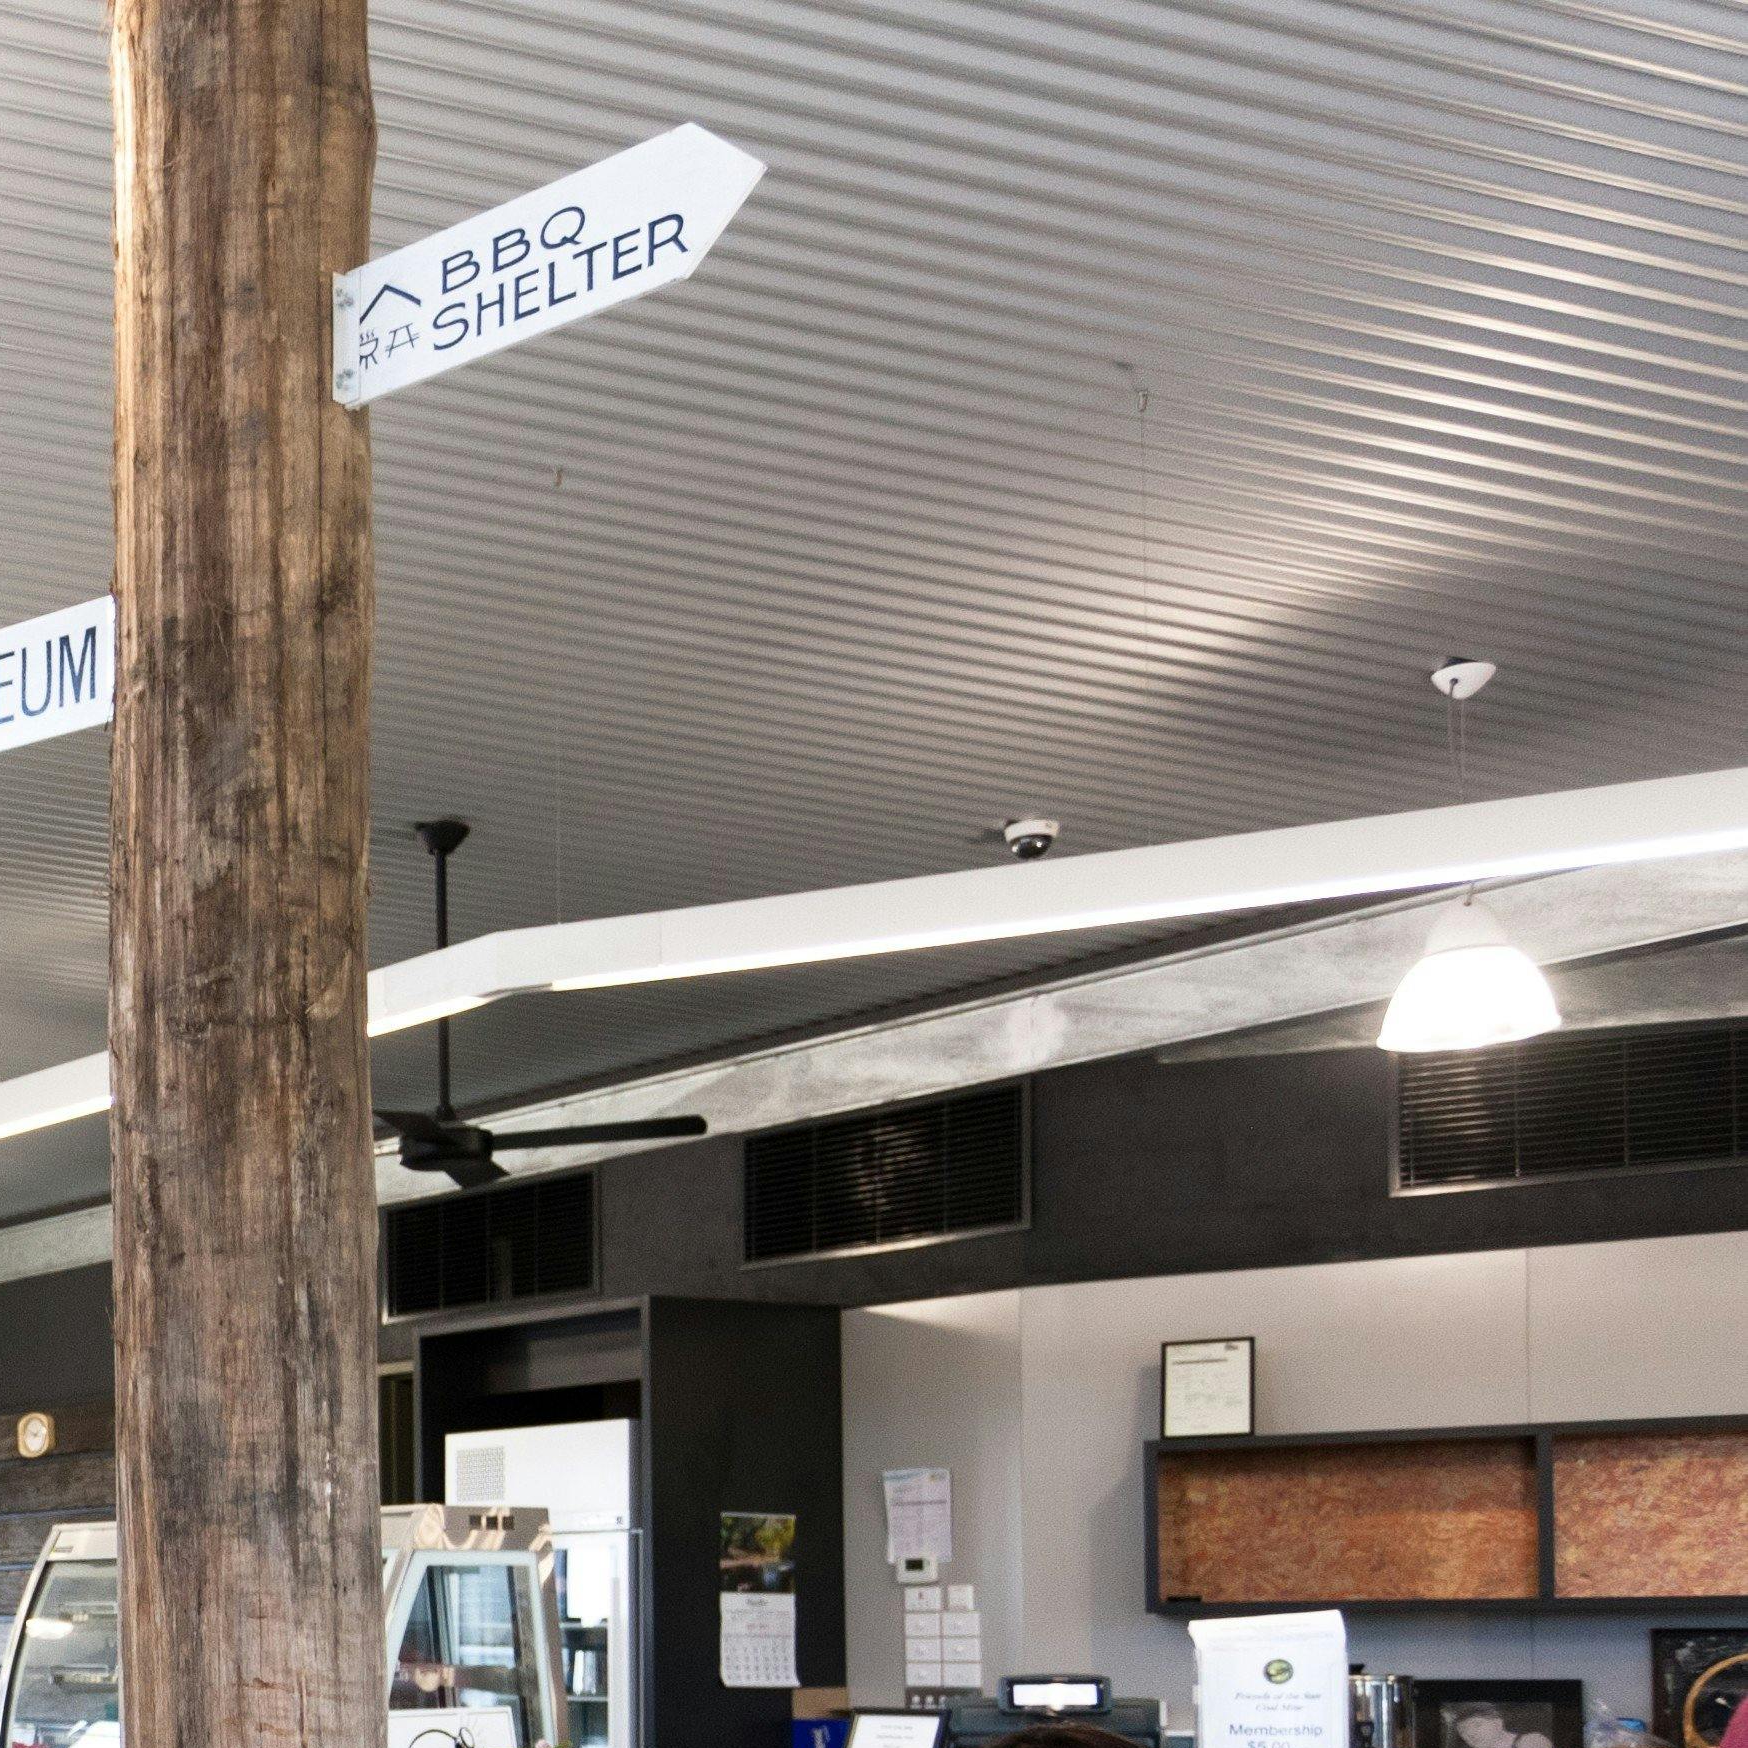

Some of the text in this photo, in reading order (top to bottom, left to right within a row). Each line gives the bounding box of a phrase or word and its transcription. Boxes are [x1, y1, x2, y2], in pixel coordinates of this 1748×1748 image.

[432, 212, 689, 351] SHELTER
[441, 205, 586, 295] BBQ
[1228, 1724, 1324, 1738] Membership
